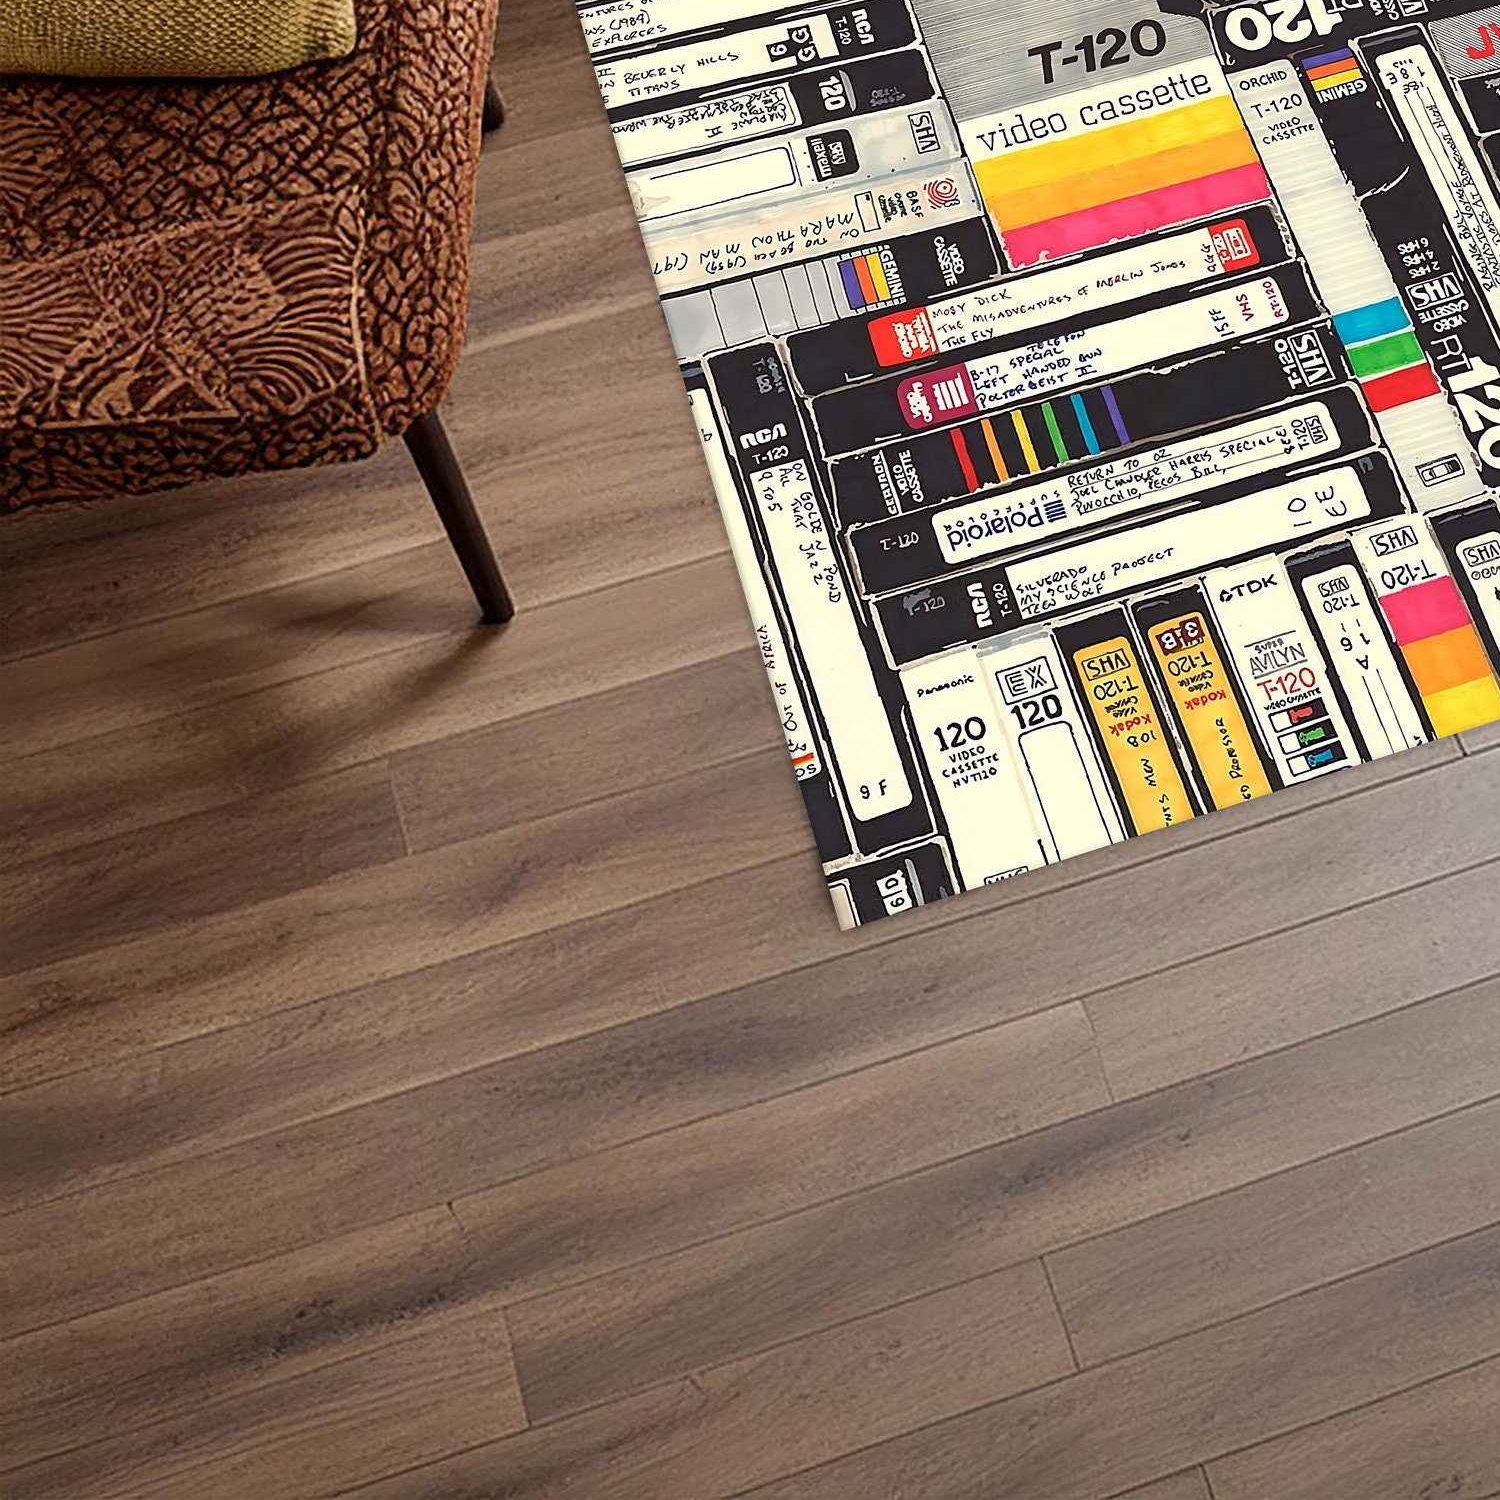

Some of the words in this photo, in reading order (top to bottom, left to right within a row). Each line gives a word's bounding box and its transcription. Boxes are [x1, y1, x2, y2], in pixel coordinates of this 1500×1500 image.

[850, 7, 875, 45] RCA
[695, 50, 739, 67] HILLS
[1027, 18, 1166, 84] T-120
[627, 78, 680, 97] TITANS
[817, 74, 846, 111] 120
[1238, 69, 1288, 91] ORCHID
[975, 112, 1067, 151] video
[1078, 73, 1211, 126] cassette
[1249, 92, 1303, 118] T-120
[910, 112, 940, 152] VHS
[1261, 122, 1315, 145] CASSETTE
[1266, 115, 1301, 132] VIDEO
[750, 211, 854, 248] MARATHON
[698, 242, 740, 264] MAN
[1261, 280, 1284, 318] RT-120
[1410, 274, 1461, 306] VHS
[1234, 292, 1255, 322] VHS
[940, 334, 967, 348] THE
[970, 326, 995, 342] FLY
[1273, 337, 1302, 389] T-120
[1290, 331, 1328, 383] VHS
[1430, 334, 1474, 371] RT
[968, 364, 999, 381] B-17
[972, 373, 1009, 391] LEFT
[1021, 356, 1071, 379] HANDED
[1077, 347, 1102, 362] GUN
[738, 422, 787, 449] RCA
[750, 444, 789, 465] T-120
[1066, 463, 1114, 488] RETURN
[1124, 458, 1140, 470] TO
[791, 461, 807, 482] ON
[822, 563, 842, 603] POND
[946, 505, 1044, 551] Polaroid
[1374, 528, 1415, 554] VHS
[1466, 541, 1500, 564] VHS
[1229, 573, 1278, 597] TDK
[1379, 558, 1437, 590] T-120
[965, 581, 993, 628] RCA
[1019, 589, 1041, 606] MY
[1085, 652, 1127, 678] VHS
[1166, 650, 1213, 677] T-120
[1248, 642, 1307, 676] AVILYN
[915, 673, 974, 698] Panasonic
[1003, 663, 1047, 697] EX
[1092, 674, 1139, 701] T-120
[1255, 666, 1316, 701] T-120
[1009, 693, 1063, 730] 120
[1183, 688, 1227, 711] Kodak
[932, 715, 986, 752] 120
[1107, 712, 1152, 736] Kodak
[941, 752, 999, 778] CASSETTE
[947, 744, 985, 763] VIDEO
